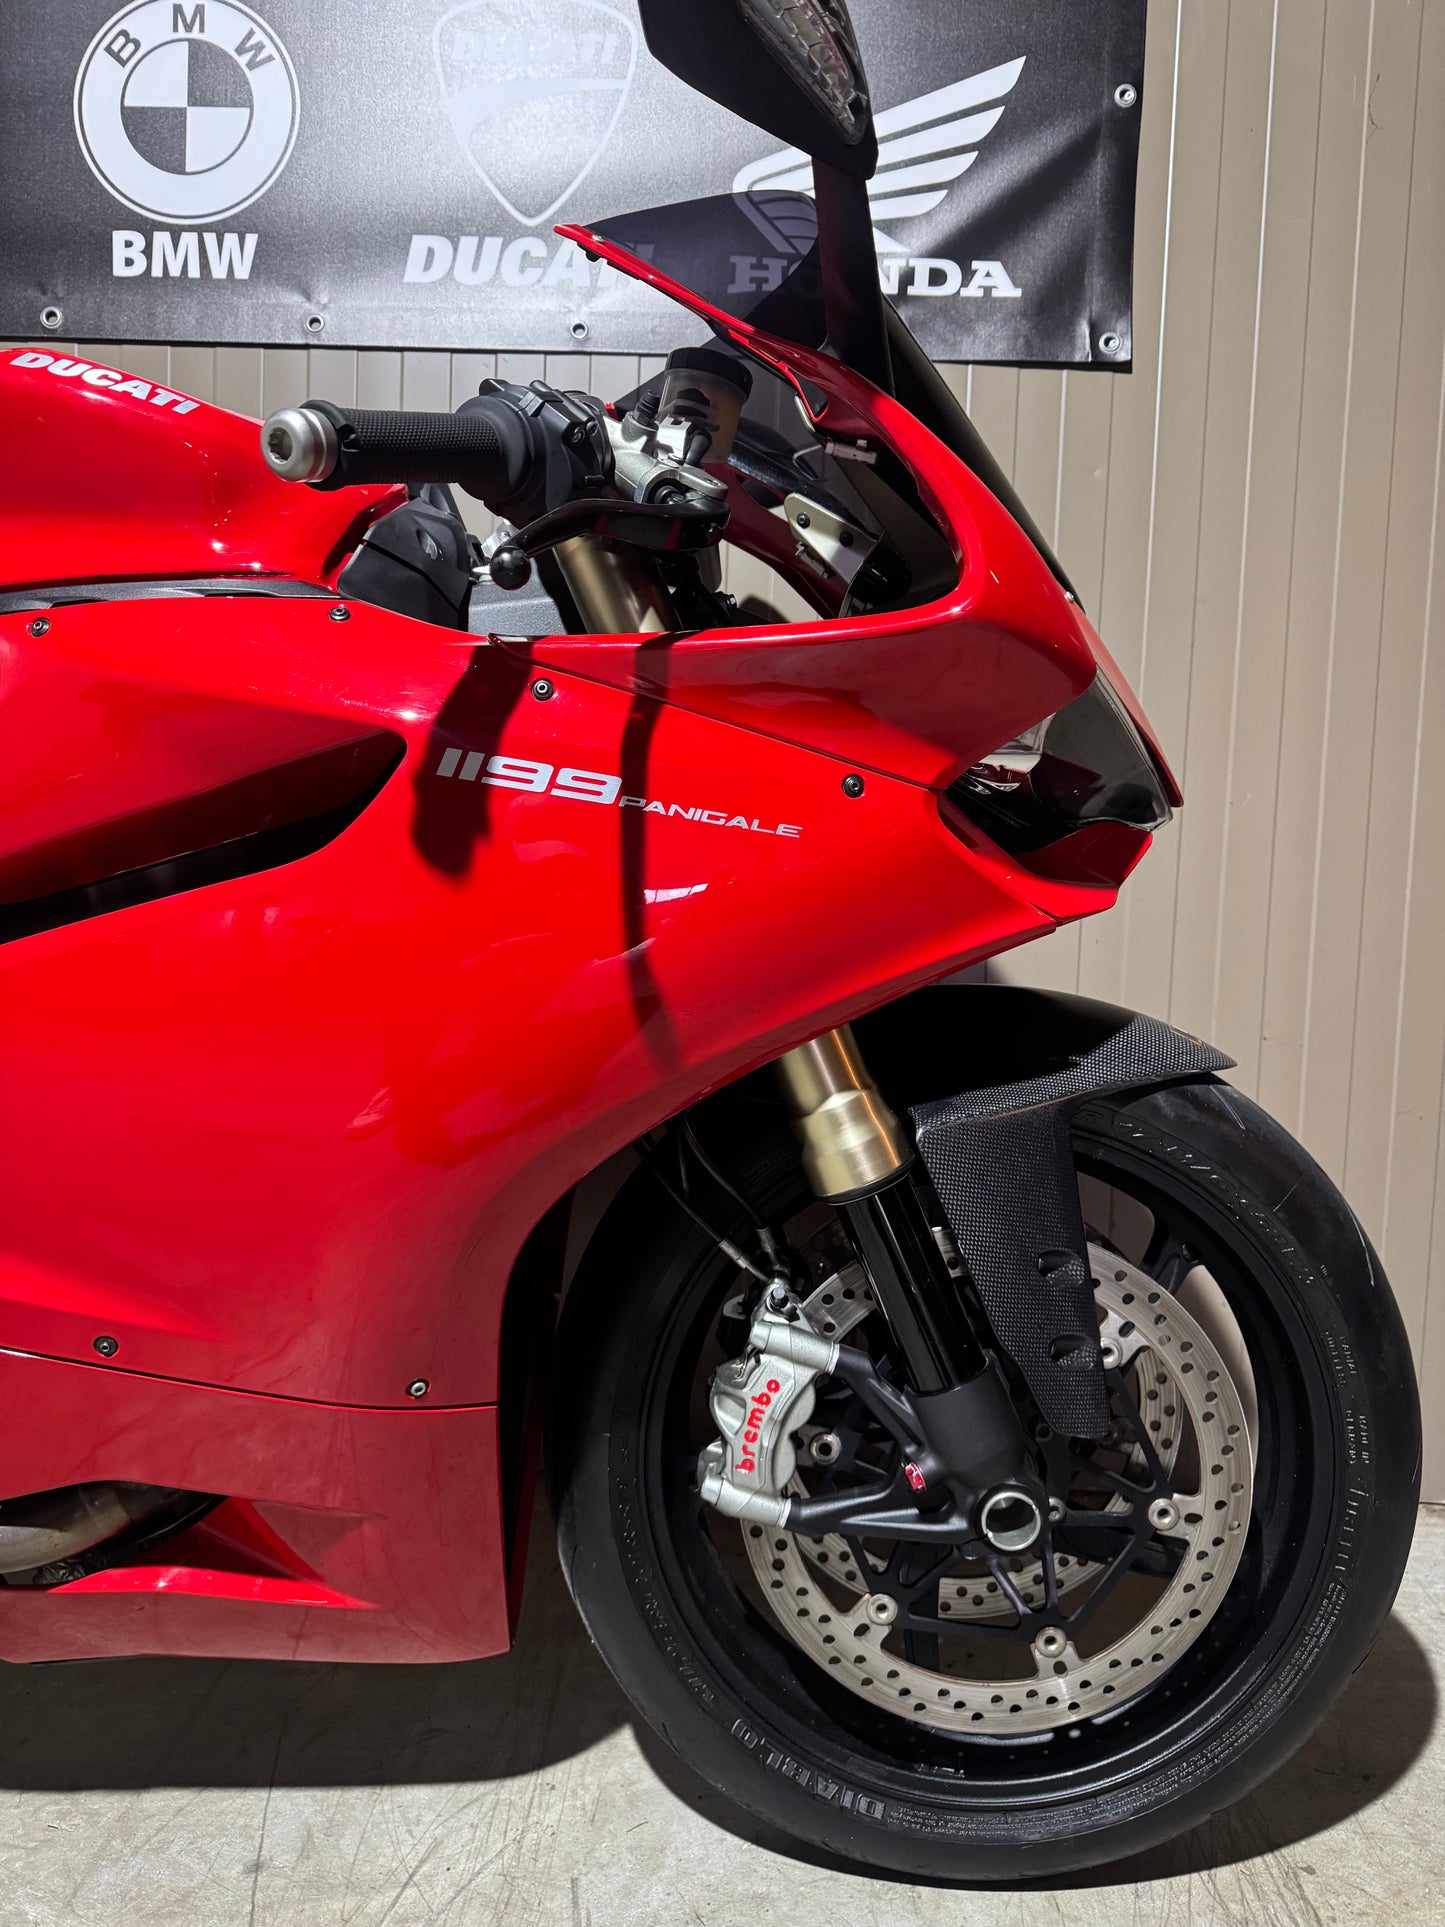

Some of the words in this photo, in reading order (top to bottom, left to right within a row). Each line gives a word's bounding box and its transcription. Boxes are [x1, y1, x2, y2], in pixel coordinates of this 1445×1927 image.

[103, 3, 276, 73] BMW
[111, 229, 259, 280] BMW
[402, 234, 655, 289] DUCA
[727, 255, 1022, 298] HDA
[9, 352, 201, 415] DUCATI
[435, 747, 623, 805] 1199
[618, 795, 804, 839] PANIGALE
[734, 1378, 781, 1475] brembo
